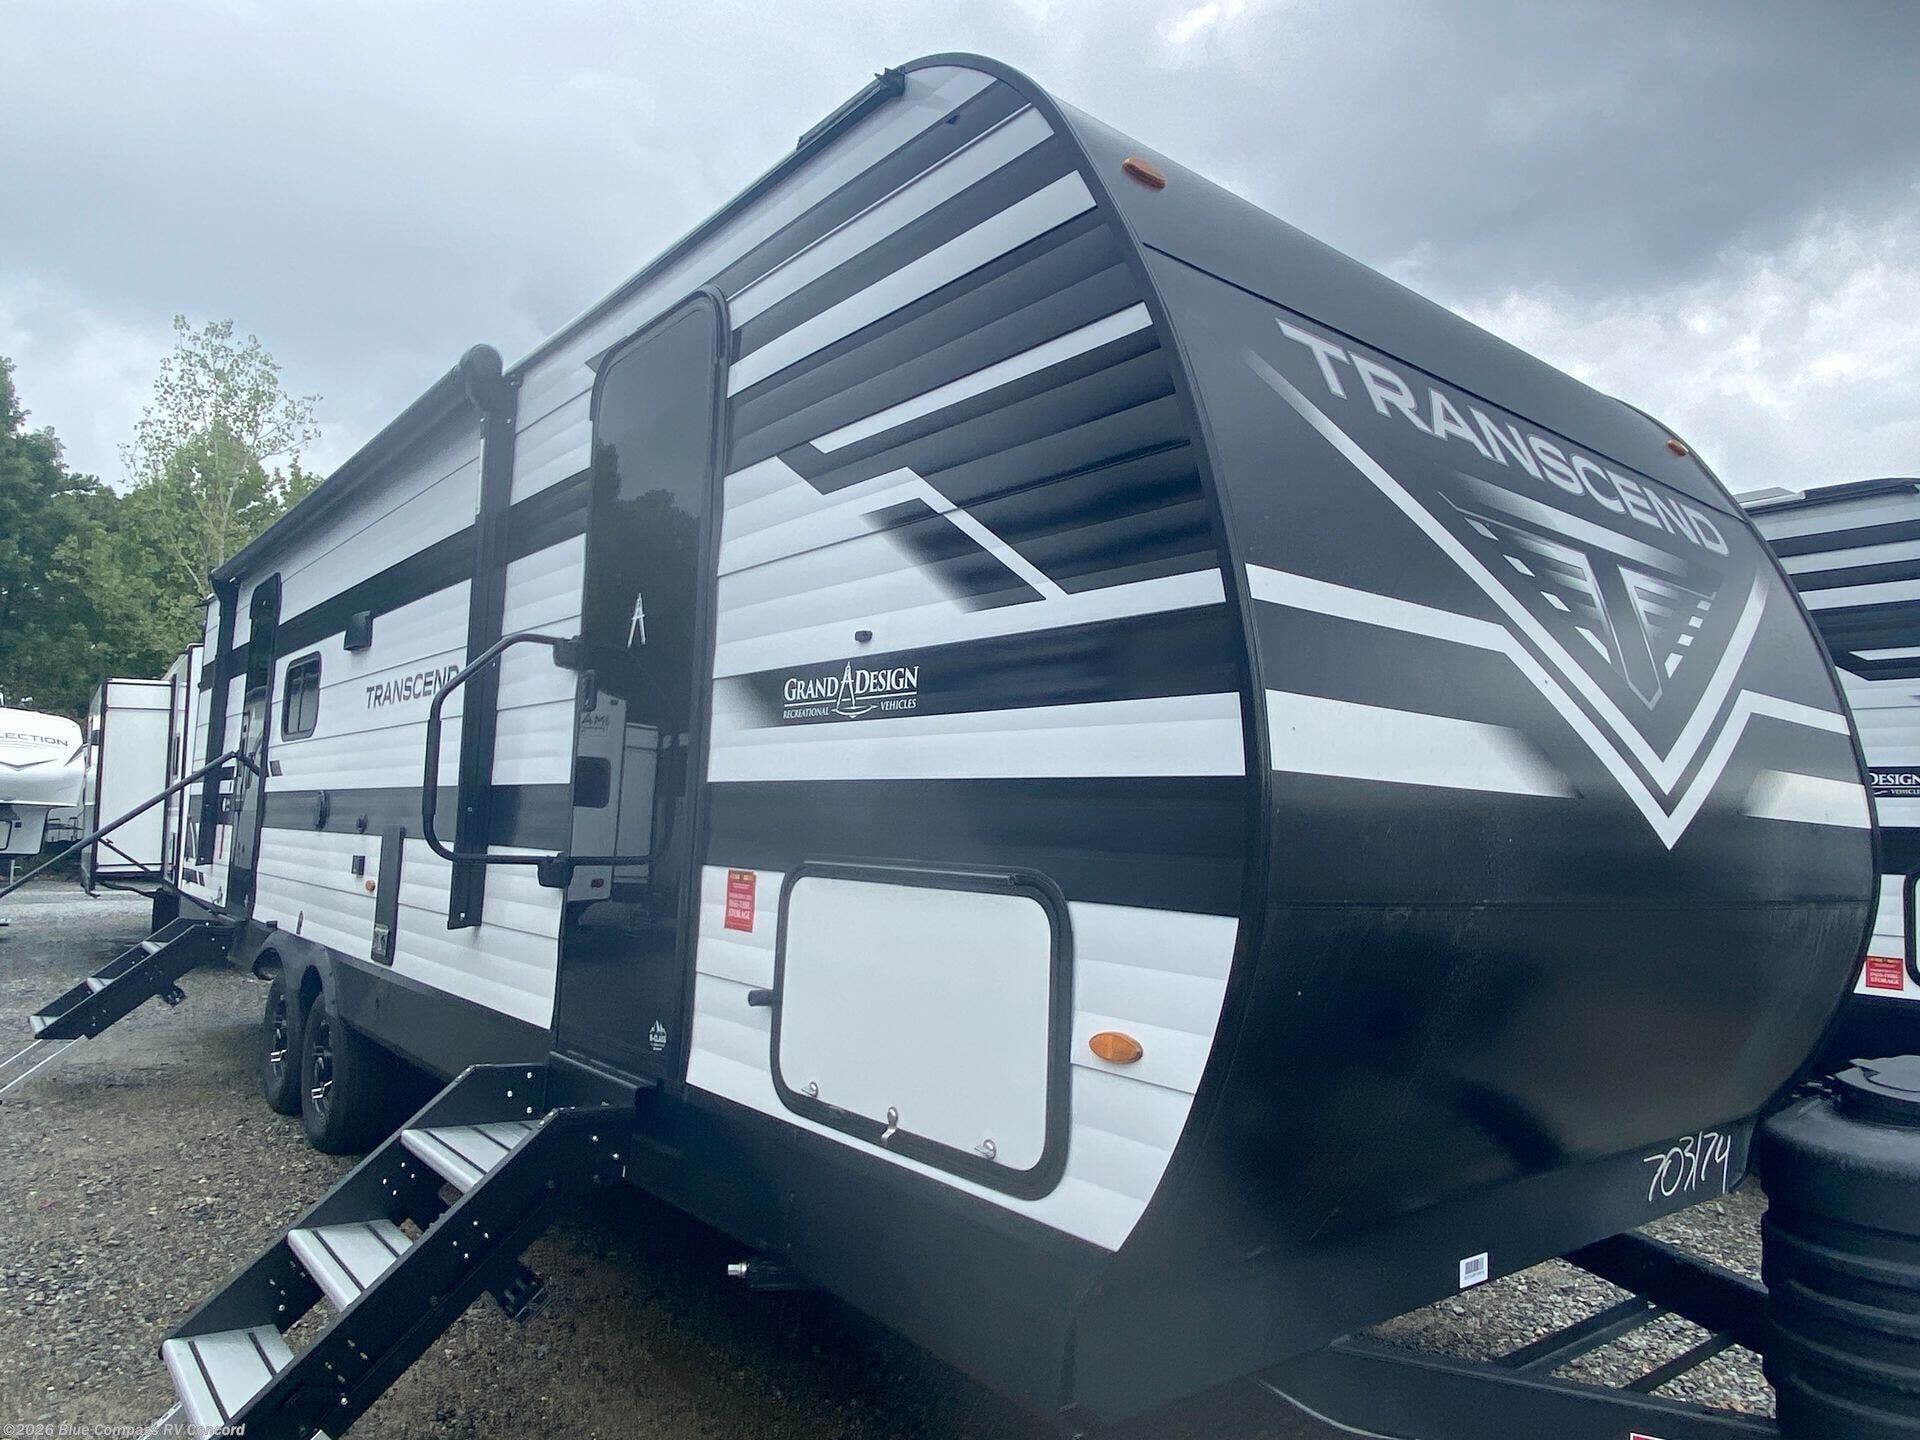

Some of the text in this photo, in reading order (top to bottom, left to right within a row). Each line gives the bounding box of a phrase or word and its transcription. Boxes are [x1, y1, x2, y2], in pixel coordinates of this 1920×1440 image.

[1275, 317, 1730, 557] TRANSCEND
[784, 665, 919, 701] GRAND DESIGN
[783, 698, 917, 719] RECREATIONAL VEHICLES
